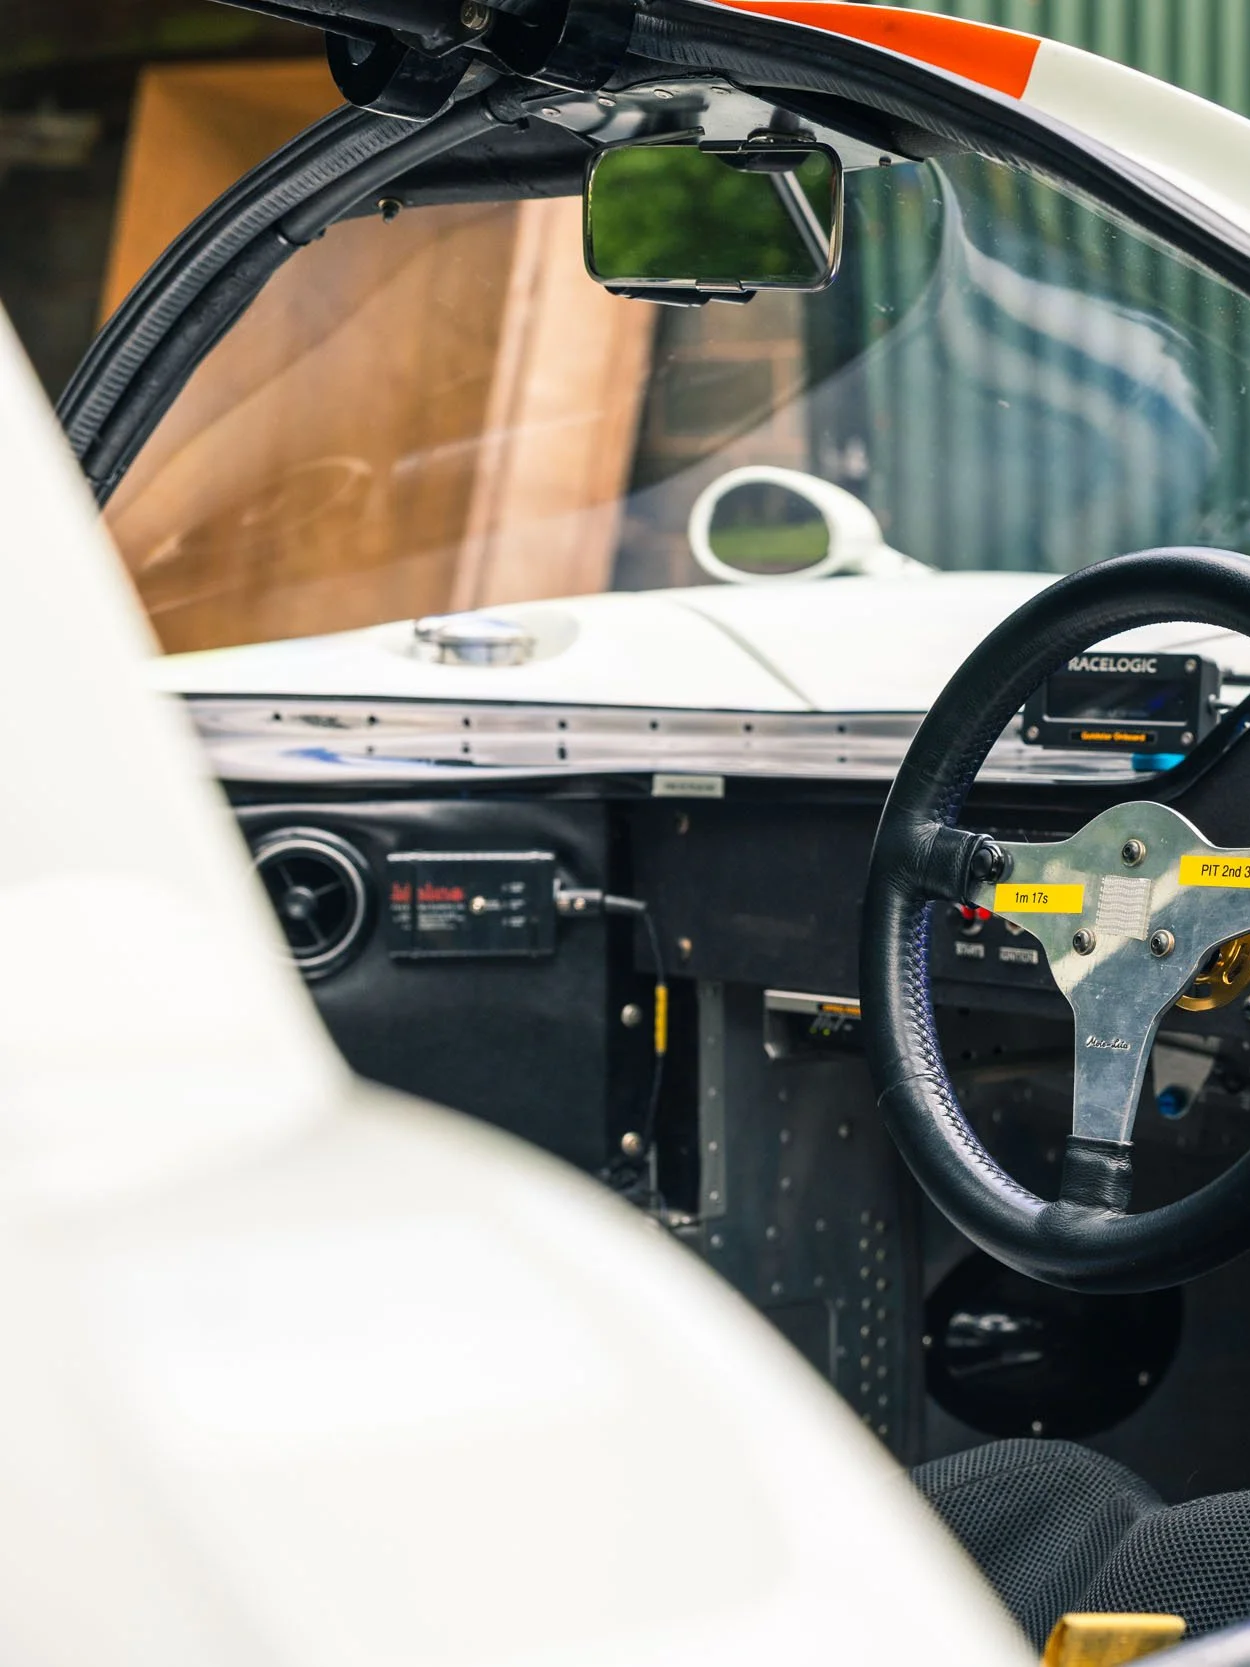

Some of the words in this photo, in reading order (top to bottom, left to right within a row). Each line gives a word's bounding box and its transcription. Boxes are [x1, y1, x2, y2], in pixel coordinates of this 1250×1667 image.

[1068, 657, 1157, 673] RACELOGIC
[1201, 864, 1220, 876] PIT
[1222, 865, 1241, 877] 2nd
[1015, 892, 1029, 903] 1m
[1032, 892, 1048, 904] 17s
